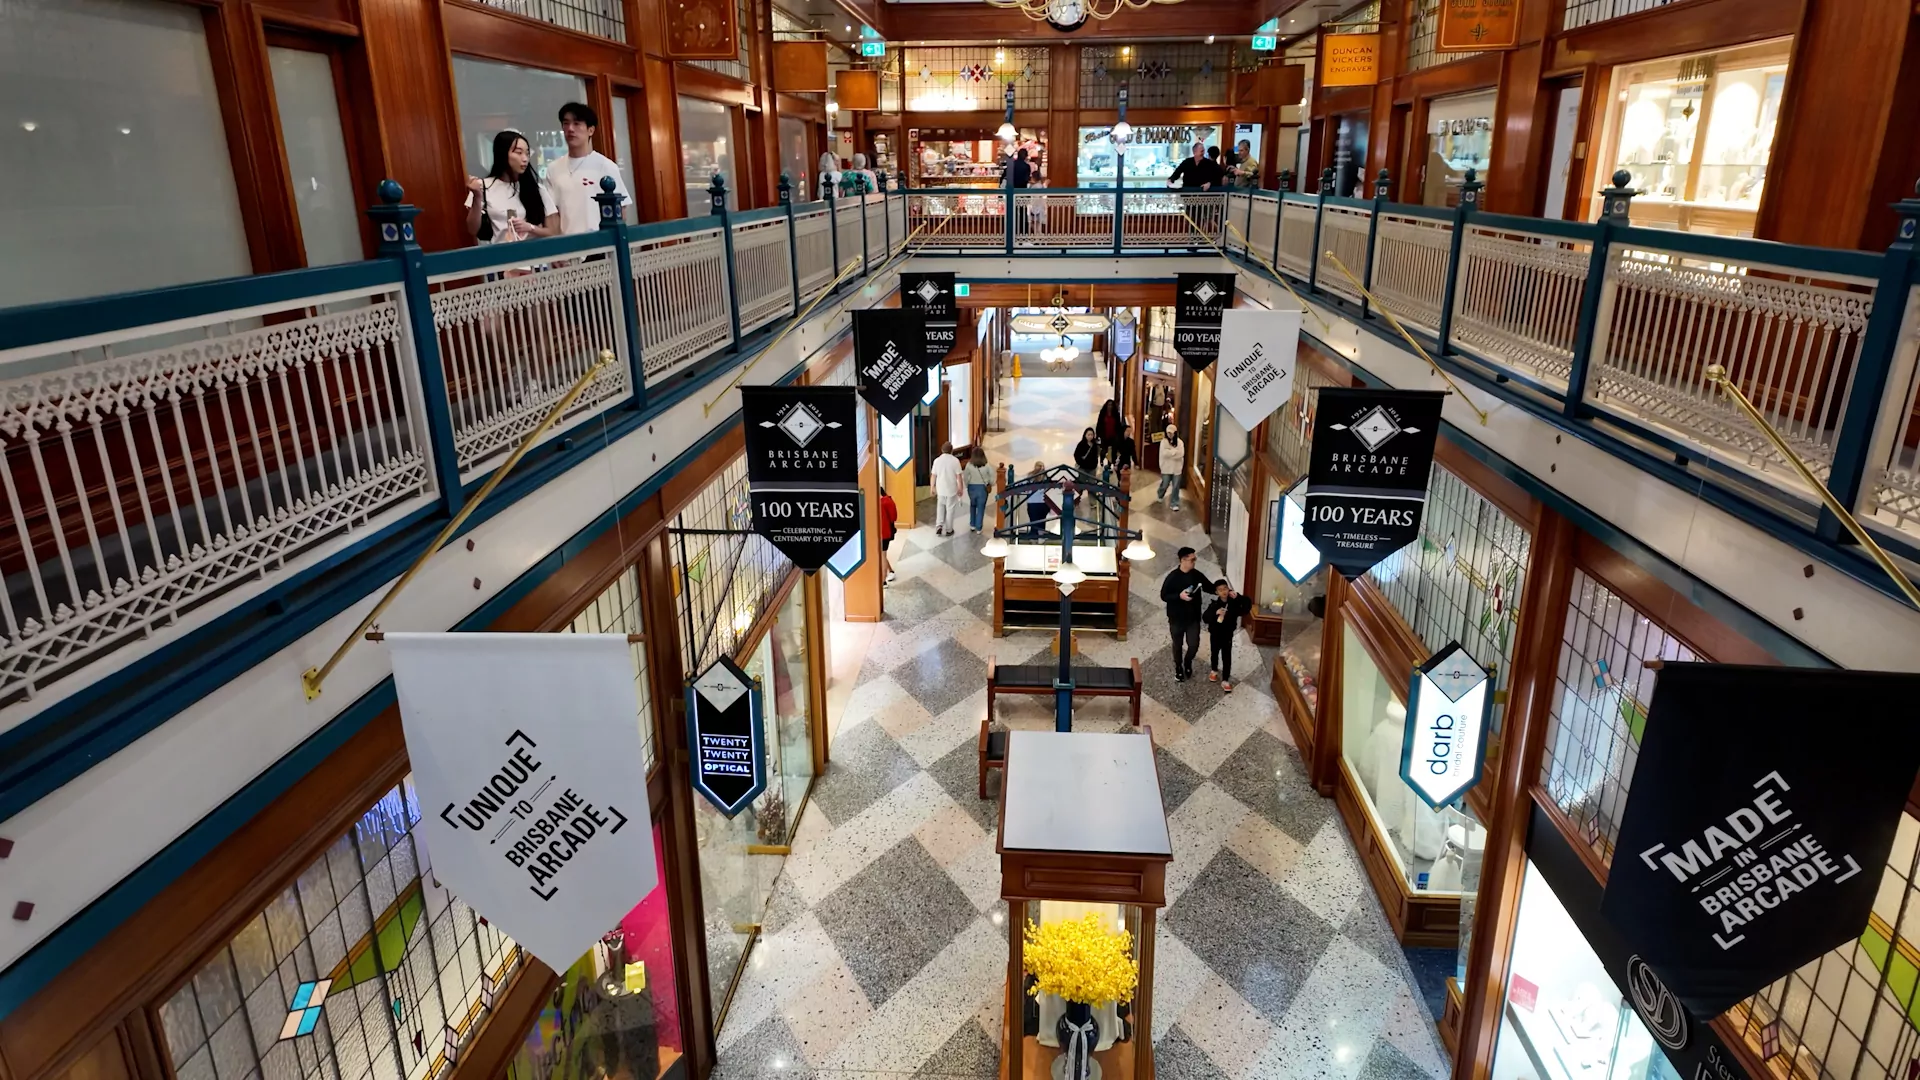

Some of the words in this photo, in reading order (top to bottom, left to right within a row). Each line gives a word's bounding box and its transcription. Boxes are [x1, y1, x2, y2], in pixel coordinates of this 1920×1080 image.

[1332, 47, 1373, 55] DUNCAN
[926, 331, 954, 340] YEARS
[1178, 333, 1194, 342] 100
[1197, 333, 1220, 342] YEAR
[868, 347, 899, 379] MADE
[1230, 348, 1263, 378] UNIQUE
[882, 359, 910, 389] BRISBANE
[888, 364, 916, 395] ARCADE
[1242, 362, 1274, 391] BRISBANE
[1248, 368, 1281, 398] ARCADE
[776, 403, 790, 417] 1924
[808, 403, 822, 418] 2024
[1350, 406, 1368, 420] 1924
[1387, 407, 1402, 423] 2024
[768, 450, 838, 459] BRISBANE
[769, 460, 838, 469] ARCADE
[1332, 453, 1409, 465] BRISBANE
[1330, 463, 1407, 475] ARCADE
[759, 502, 792, 518] 100
[796, 502, 855, 518] YEARS
[1311, 505, 1345, 522] 100
[1350, 507, 1414, 527] YEARS
[1336, 541, 1375, 549] TREASURE
[1342, 533, 1379, 541] TIMELESS
[702, 737, 748, 747] TWENTY
[1457, 714, 1468, 749] couture
[703, 750, 749, 760] TWENTY
[1426, 714, 1454, 775] darb
[704, 763, 750, 773] OPTICAL
[1453, 751, 1463, 777] bridal
[457, 747, 542, 831] UNIQUE
[509, 799, 534, 820] TO
[504, 788, 584, 868] BRISBANE
[1660, 789, 1792, 883] MADE
[527, 803, 609, 887] ARCADE
[1733, 847, 1758, 868] IN
[1700, 834, 1822, 915] BRISBANE
[1720, 850, 1840, 934] ARCADE
